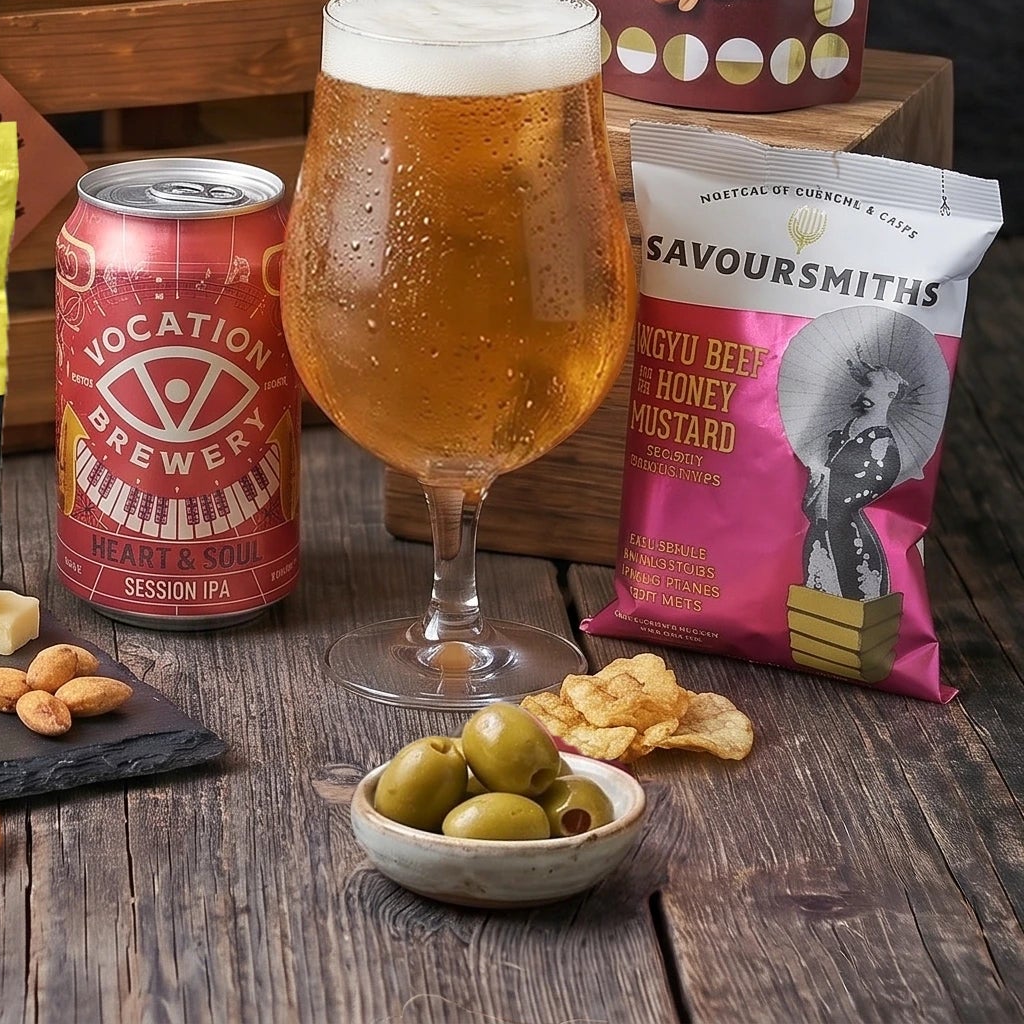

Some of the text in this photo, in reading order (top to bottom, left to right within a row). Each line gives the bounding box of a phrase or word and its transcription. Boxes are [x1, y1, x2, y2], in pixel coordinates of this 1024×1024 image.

[866, 205, 875, 216] &
[646, 234, 940, 308] SAVOURSMITHS
[83, 311, 272, 372] VOCATION
[703, 337, 770, 380] BEEF
[655, 368, 737, 414] HONEY
[86, 403, 267, 475] BREWERY
[630, 399, 737, 454] MUSTARD
[91, 533, 173, 571] HEART
[179, 546, 200, 571] &
[203, 535, 264, 570] SOUL
[124, 577, 231, 601] SESSION IPA
